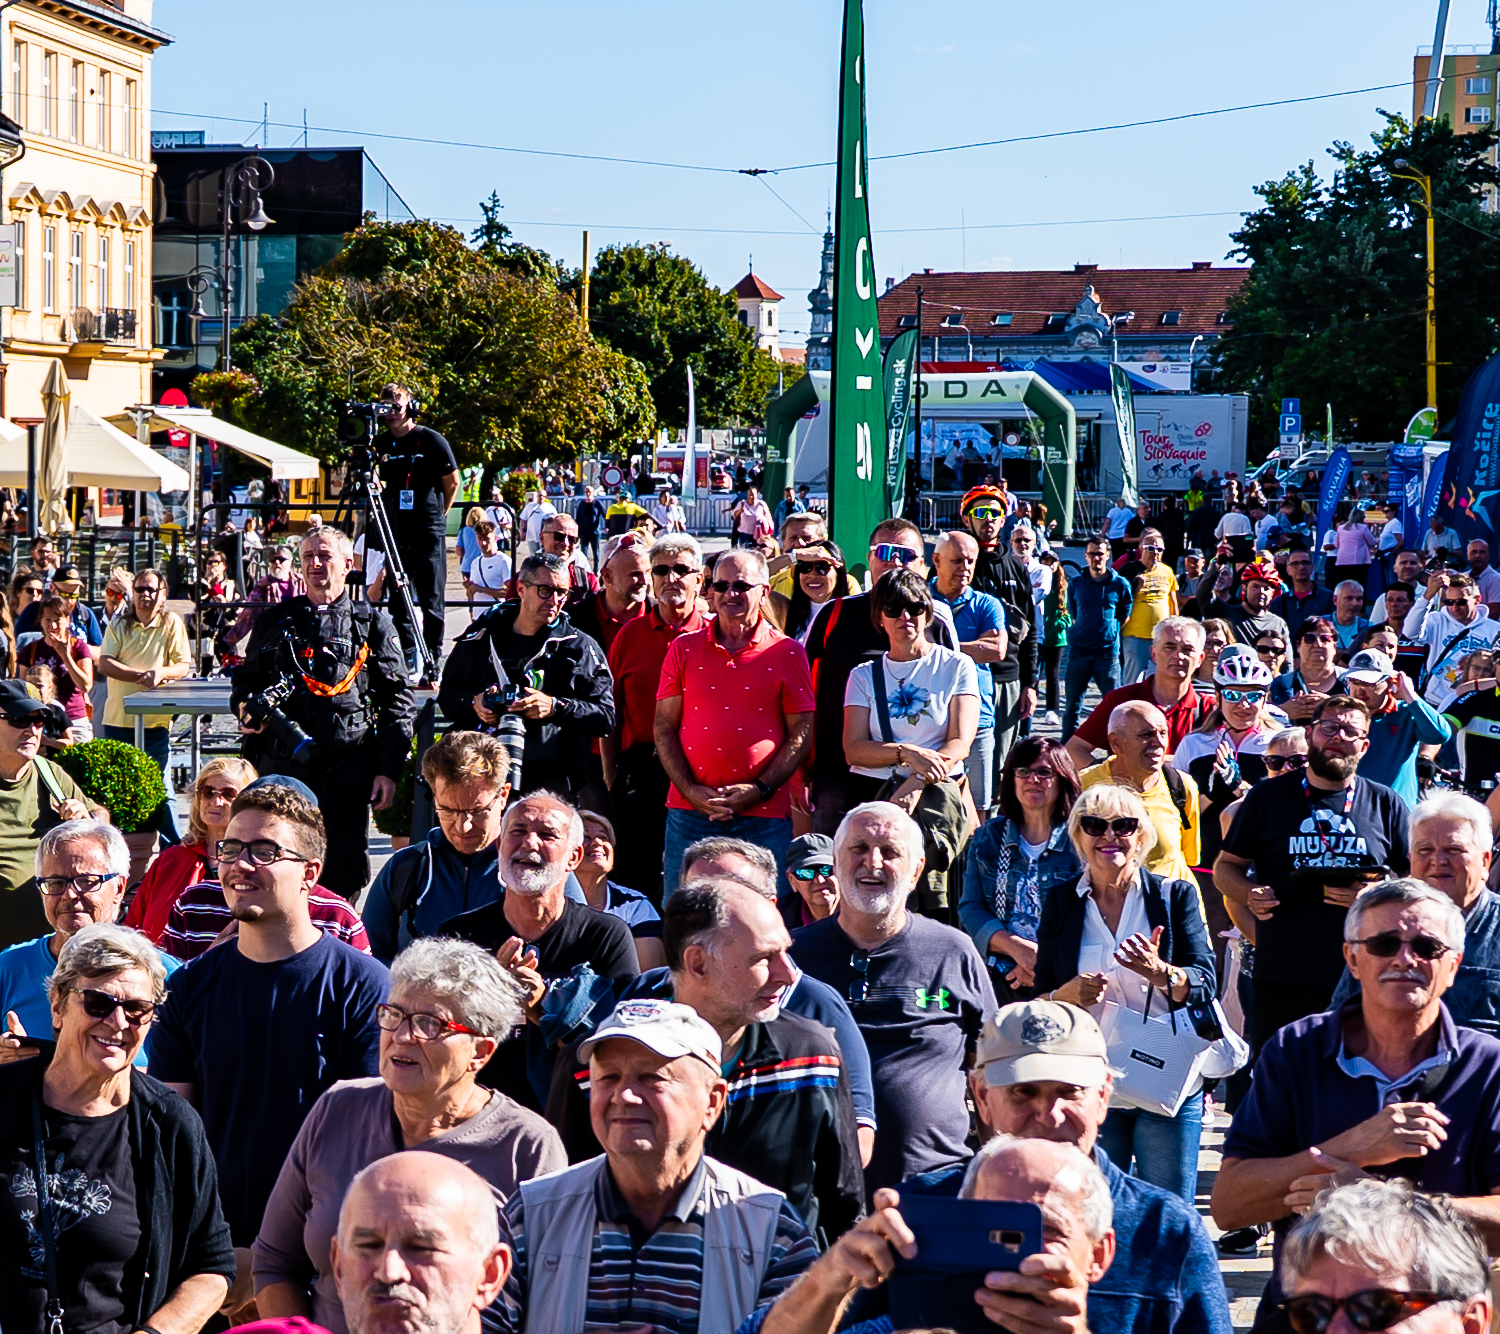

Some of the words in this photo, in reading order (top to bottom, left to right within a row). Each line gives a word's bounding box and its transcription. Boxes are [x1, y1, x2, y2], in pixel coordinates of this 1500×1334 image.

[911, 379, 1007, 399] ODA
[1285, 418, 1295, 432] P
[1139, 430, 1170, 446] Tour
[1144, 444, 1207, 463] Slovaquie
[1322, 457, 1347, 513] SLOVAKIA
